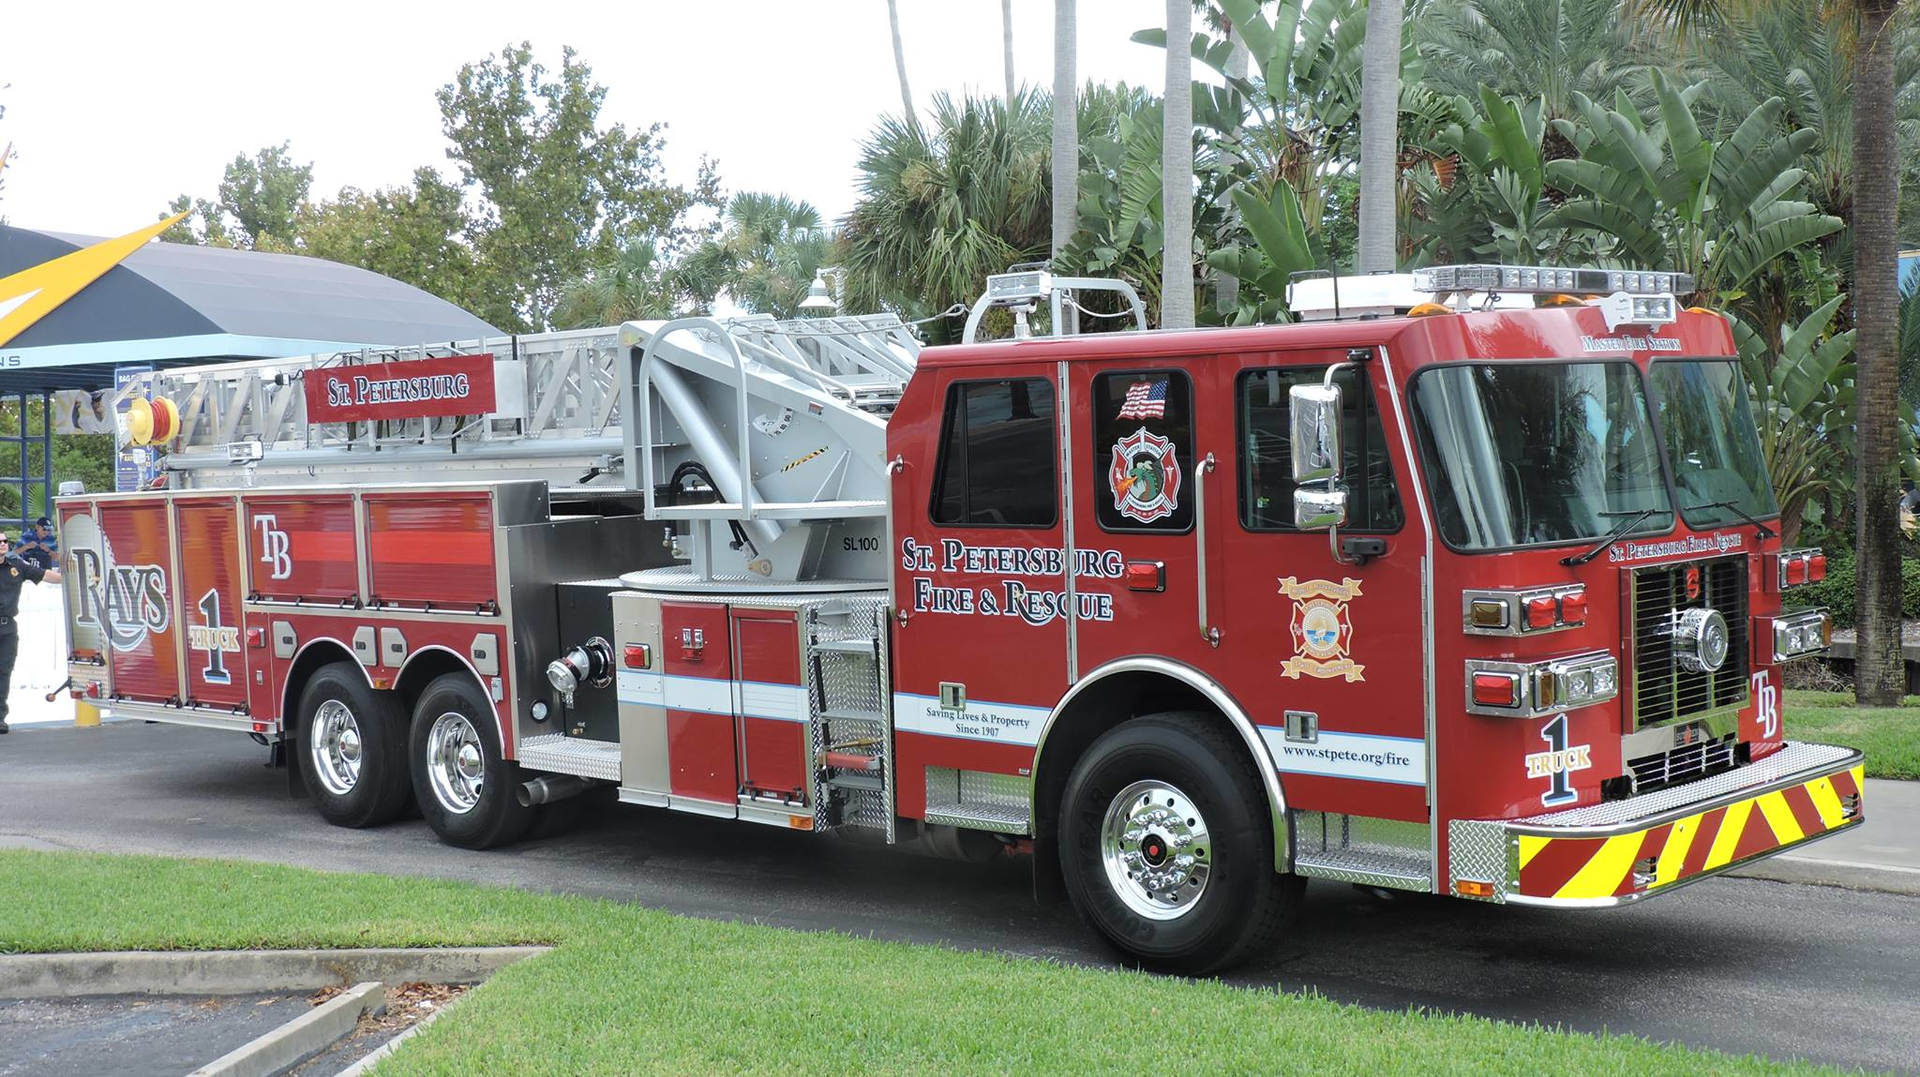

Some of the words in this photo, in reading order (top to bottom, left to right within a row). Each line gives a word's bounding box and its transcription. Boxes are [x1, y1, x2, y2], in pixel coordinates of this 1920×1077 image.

[914, 577, 974, 615] FIRE
[979, 589, 999, 615] &
[190, 626, 240, 652] TRUCK
[199, 588, 231, 684] 1
[926, 707, 955, 721] Saving
[956, 711, 979, 722] Lives
[981, 712, 988, 722] &
[990, 714, 1030, 729] Property
[1753, 669, 1777, 739] TB
[956, 723, 979, 735] Since
[982, 726, 999, 737] 1907
[1283, 745, 1410, 767] www.stpete.org/fire
[1525, 744, 1591, 778] TRUCK
[1541, 713, 1578, 806] 1
